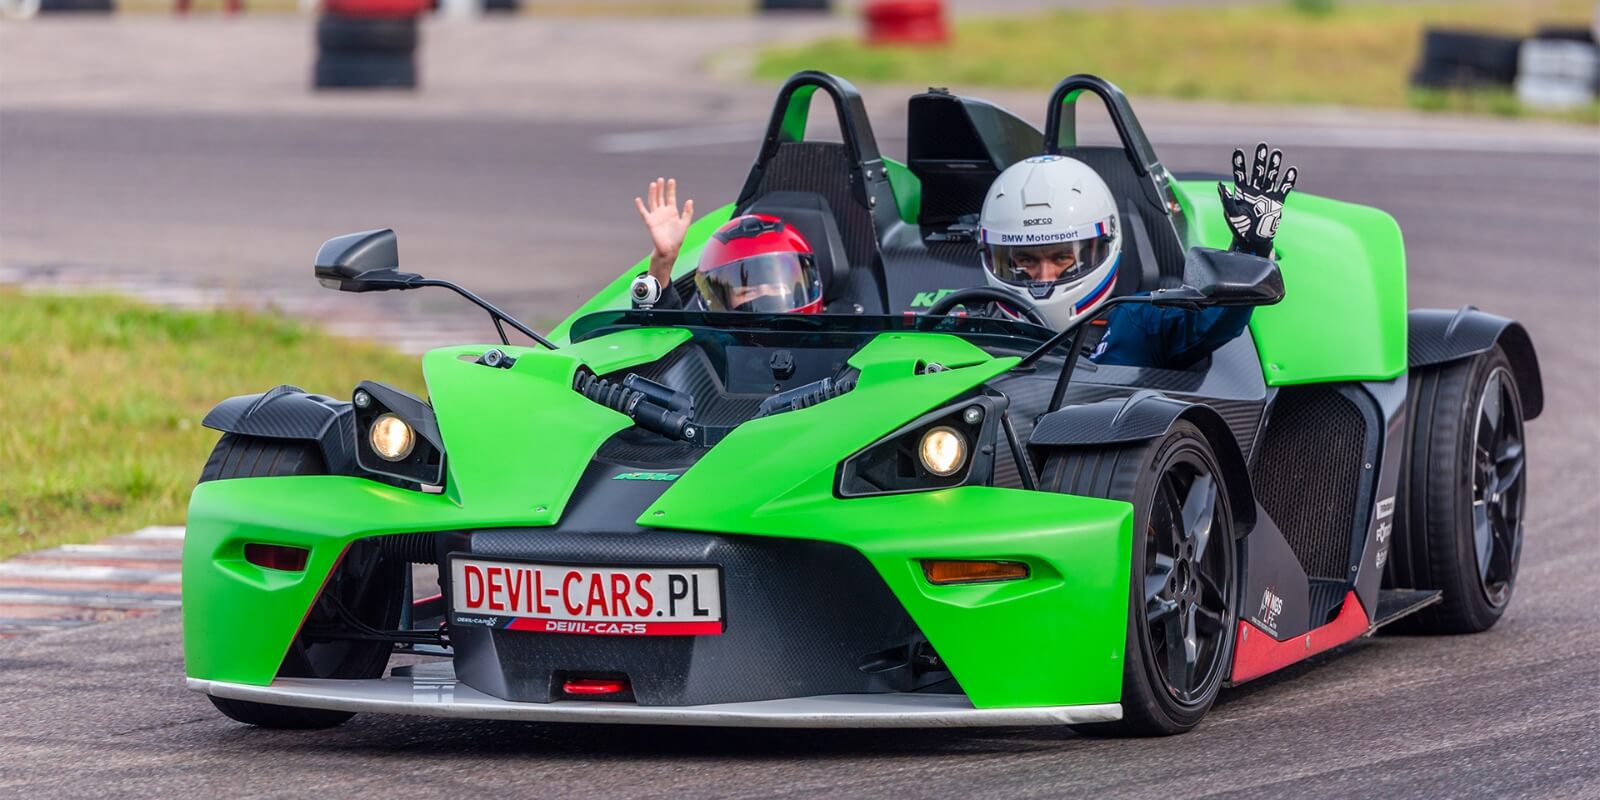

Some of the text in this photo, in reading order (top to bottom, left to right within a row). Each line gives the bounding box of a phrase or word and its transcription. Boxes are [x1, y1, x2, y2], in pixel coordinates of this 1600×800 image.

[1023, 217, 1053, 227] sparco
[1002, 230, 1079, 243] BMW Motorsport
[463, 564, 710, 617] DEVIL-CARS.PL
[545, 620, 647, 634] DEVIL-CARS
